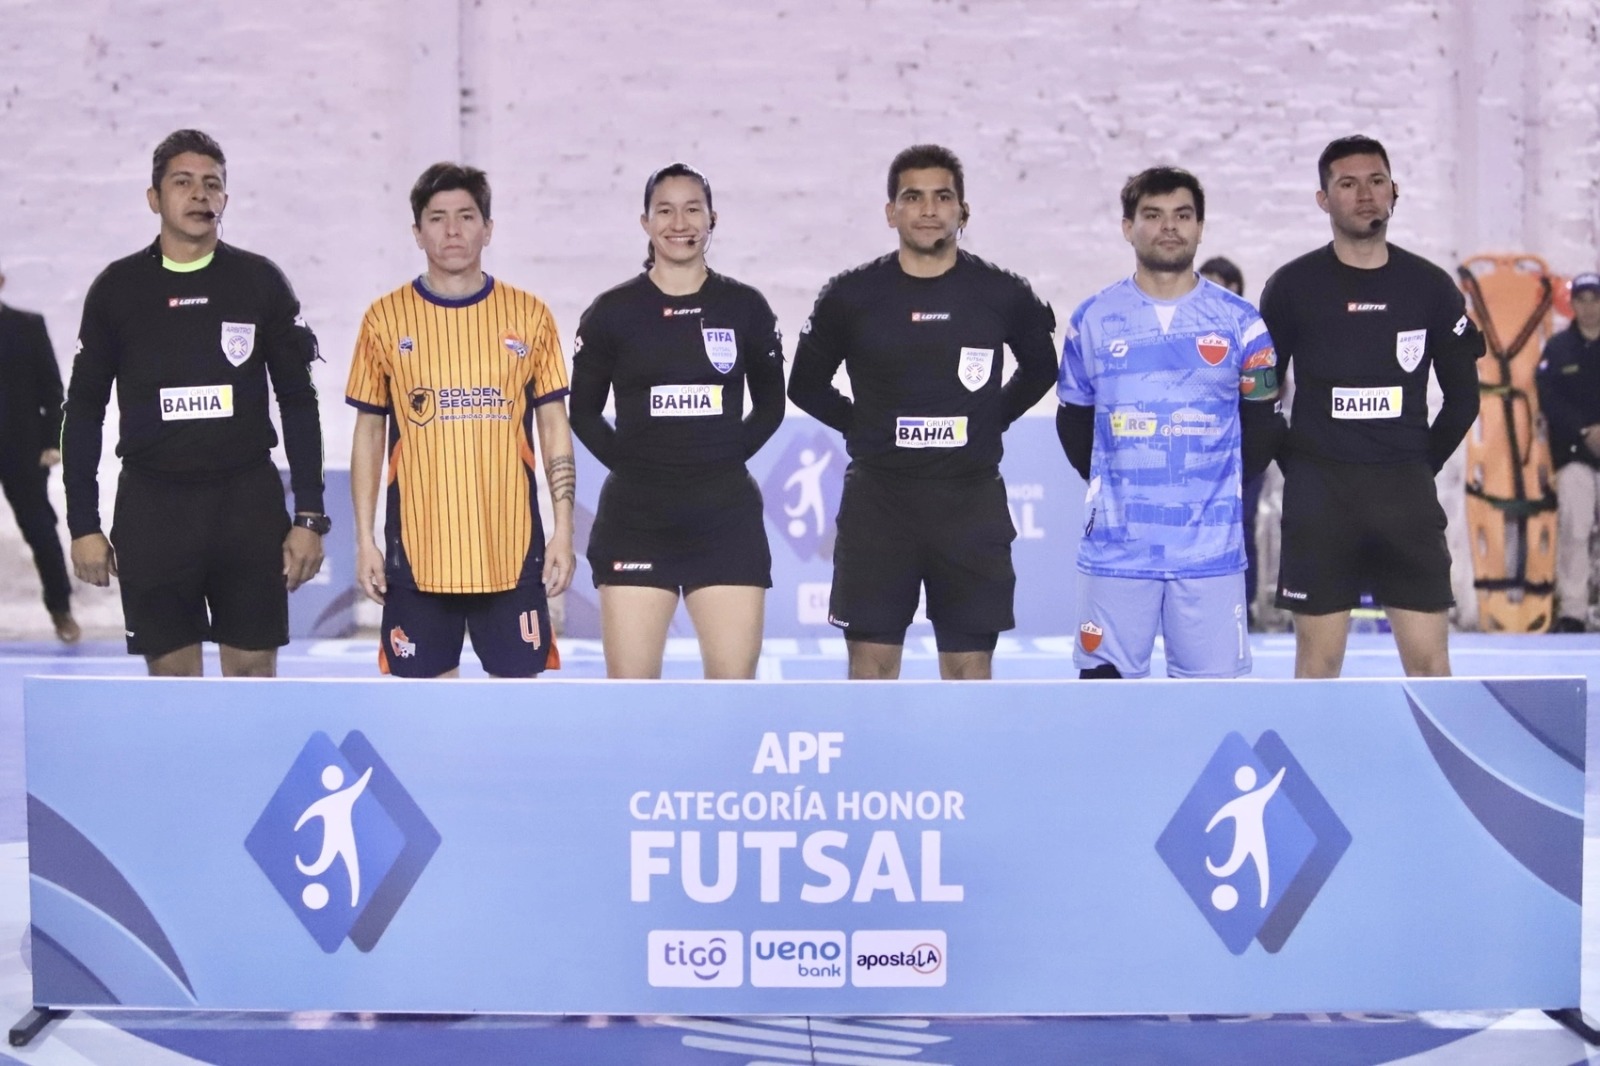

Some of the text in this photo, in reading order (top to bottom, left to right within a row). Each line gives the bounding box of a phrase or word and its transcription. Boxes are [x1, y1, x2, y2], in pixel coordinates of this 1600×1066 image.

[179, 297, 209, 306] LOTTO
[1357, 303, 1387, 311] LOTTO
[673, 307, 702, 316] LOTTO
[706, 331, 733, 343] FIFA
[190, 388, 220, 396] GRUPO
[438, 387, 501, 398] GOLDEN
[681, 386, 711, 395] GRUPO
[1361, 389, 1390, 397] GRUPO
[162, 395, 222, 414] BAHIA
[652, 394, 712, 409] BAHIA
[1334, 396, 1390, 412] BAHIA
[1128, 418, 1147, 431] Re
[898, 427, 955, 441] BAHIA
[622, 562, 652, 570] LOTTO
[519, 609, 541, 650] 4
[752, 731, 844, 774] APF
[629, 785, 966, 821] CATEGORÍA HONOR
[630, 830, 965, 904] FUTSAL
[755, 941, 841, 961] ueno
[798, 963, 841, 977] bank
